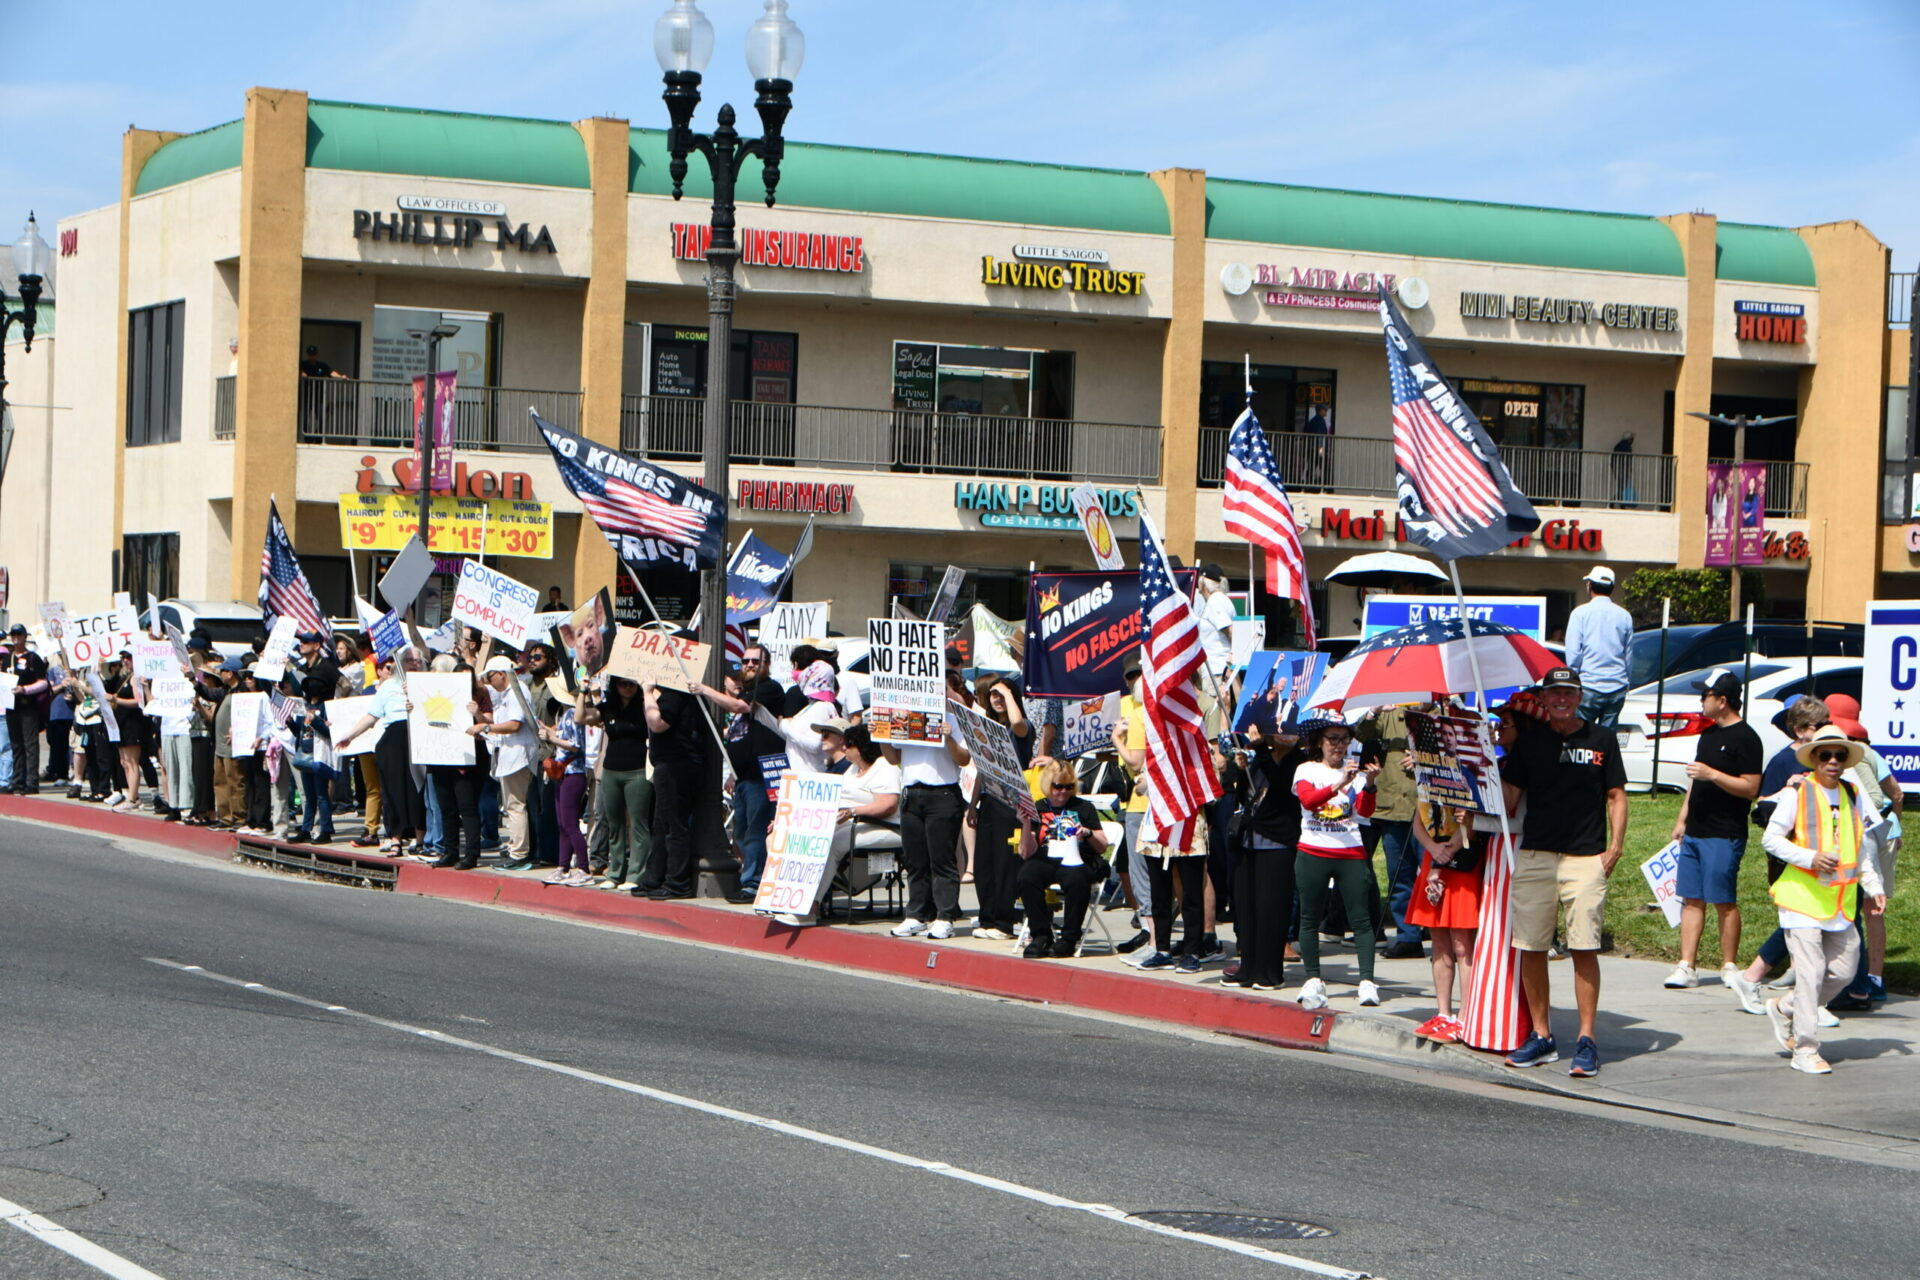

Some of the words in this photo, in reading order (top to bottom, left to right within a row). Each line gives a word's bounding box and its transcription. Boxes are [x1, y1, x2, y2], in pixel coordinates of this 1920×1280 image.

[406, 196, 432, 207] LAW
[436, 199, 480, 212] OFFICES
[483, 202, 498, 213] OF
[353, 209, 484, 249] PHILLIP
[497, 221, 558, 254] MA
[743, 227, 863, 272] INSURANCE
[1021, 246, 1059, 257] LITTLE
[1062, 249, 1103, 260] SAIGON
[984, 255, 1064, 289] LIVING
[1070, 262, 1146, 296] TRUST
[1289, 266, 1398, 294] MIRACLE
[1291, 294, 1336, 307] PRINCESS
[1338, 297, 1381, 311] Cosmetics
[1461, 291, 1507, 318] MIMI
[1514, 295, 1595, 325] BEAUTY
[1603, 303, 1680, 331] CENTER
[1742, 302, 1768, 312] LITTLE
[1737, 315, 1807, 344] HOME
[658, 361, 680, 369] Home
[659, 352, 679, 361] Auto
[657, 377, 673, 385] Life
[658, 369, 682, 377] Health
[657, 385, 691, 395] Medicare
[1504, 400, 1539, 418] OPEN
[355, 455, 377, 493] i
[392, 457, 532, 500] Slon
[585, 446, 676, 499] KINGS
[681, 489, 714, 515] IN
[358, 496, 377, 505] MEN
[414, 498, 433, 506] MN
[457, 498, 490, 508] WOMEN
[512, 502, 541, 512] WOMEN
[739, 479, 855, 514] PHARMACY
[955, 482, 1009, 511] HAN
[1017, 485, 1033, 511] P
[346, 509, 385, 517] HAIRCUT
[393, 510, 410, 518] CUT
[455, 512, 493, 521] HAIRCT
[500, 515, 514, 523] CUT
[523, 516, 548, 526] COLOR
[352, 522, 377, 545] $9
[452, 526, 484, 549] $15
[500, 529, 537, 553] $30
[1542, 519, 1603, 551] Gia
[602, 530, 698, 572] ERICA
[463, 562, 538, 609] CONGRESS
[489, 592, 502, 609] IS
[616, 596, 634, 607] NH'S
[1041, 610, 1062, 641] NO
[1063, 581, 1114, 627] KINGS
[455, 594, 526, 641] COMPLICIT
[616, 608, 642, 620] RMACY
[776, 607, 817, 639] AMY
[1428, 605, 1494, 621] RE-EECT
[74, 614, 120, 637] ICE
[869, 620, 893, 646] NO
[899, 622, 938, 650] HATE
[74, 632, 133, 661] OUT
[631, 630, 700, 661] D.A.RE.
[1065, 643, 1089, 673] NO
[1090, 608, 1142, 660] FASCIS
[871, 647, 893, 672] NO
[899, 650, 940, 678] FEAR
[873, 675, 936, 694] IMMIGRANTS
[872, 692, 887, 702] ARE
[888, 694, 923, 706] WELCOME
[1068, 723, 1114, 748] KINGS
[1079, 715, 1101, 733] NO
[782, 775, 842, 803] TYRANT
[776, 802, 835, 831] RAPIST
[770, 830, 831, 857] UNHINGED
[755, 882, 804, 909] PEDO
